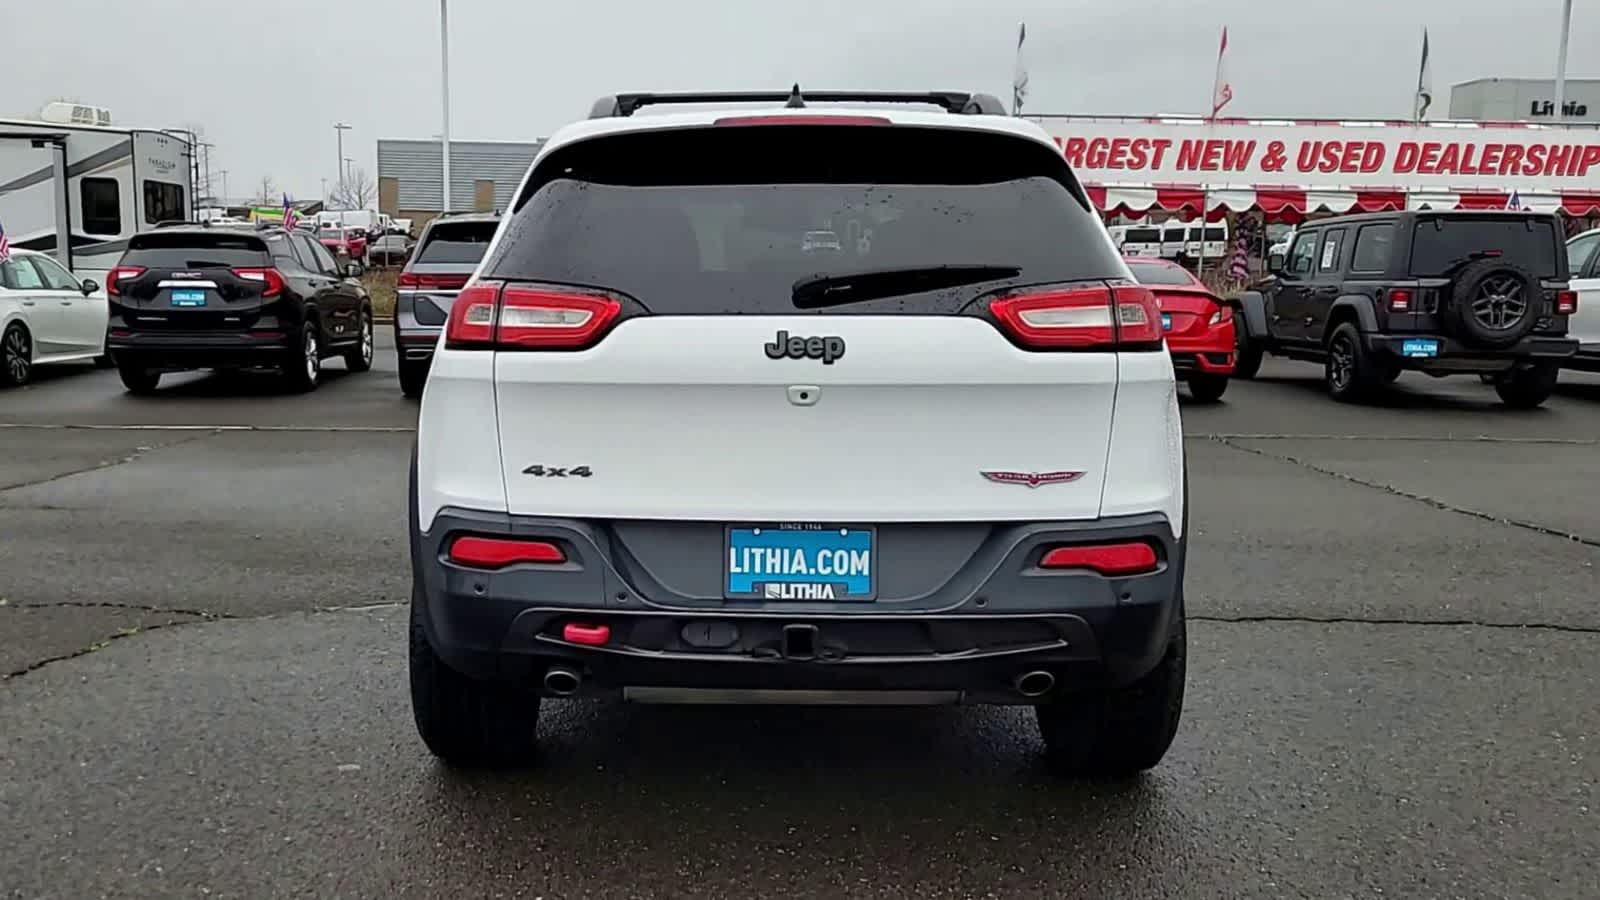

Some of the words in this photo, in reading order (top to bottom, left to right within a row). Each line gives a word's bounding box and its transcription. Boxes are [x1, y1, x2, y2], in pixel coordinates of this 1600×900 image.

[1176, 139, 1257, 173] NEW
[1260, 140, 1288, 172] &
[1296, 140, 1386, 174] USED
[1393, 142, 1600, 177] DEALERSHIP
[764, 330, 846, 365] Jeep
[522, 465, 593, 477] 4x4
[729, 547, 870, 576] LITHIA.COM
[781, 583, 834, 599] LITHIA
